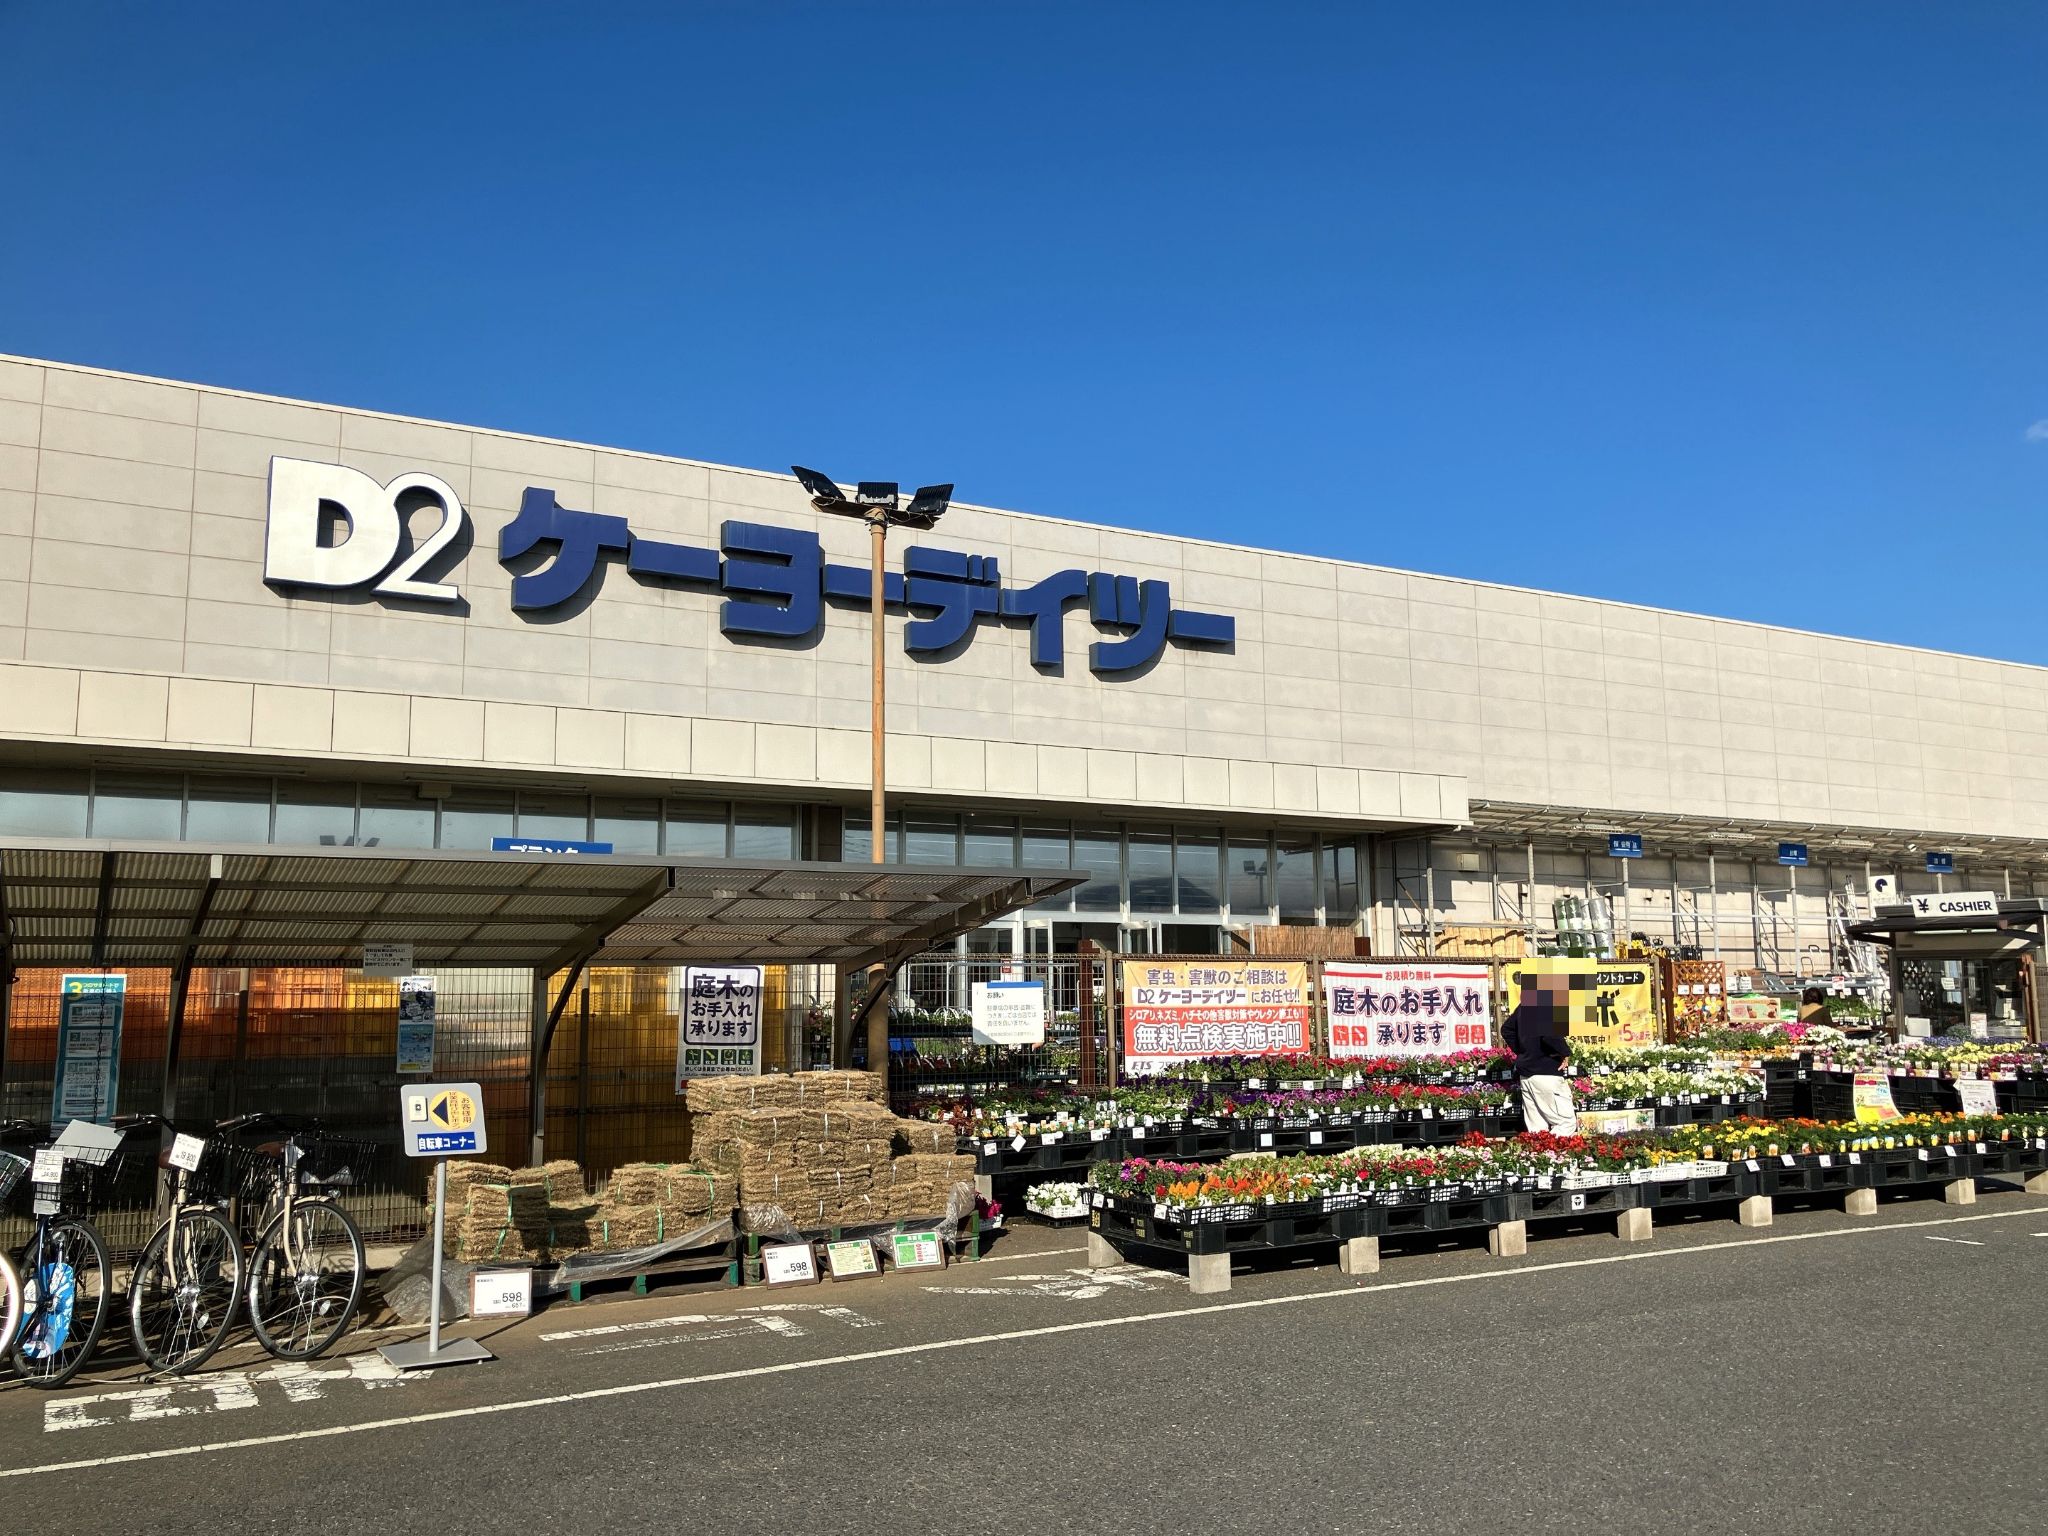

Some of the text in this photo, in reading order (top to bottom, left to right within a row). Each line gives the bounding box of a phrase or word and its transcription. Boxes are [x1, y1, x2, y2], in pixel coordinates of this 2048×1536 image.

[264, 456, 462, 601] D2
[1939, 900, 1993, 913] CASHIER
[1147, 968, 1288, 986] 害虫・害獣のご相談は
[1384, 971, 1432, 981] お見積り無料
[1597, 972, 1640, 984] イントカード
[691, 974, 754, 999] 庭木の
[1137, 988, 1155, 1004] D2
[1332, 986, 1484, 1016] 庭木のお手入れ
[690, 1001, 753, 1017] お手入れ
[690, 1020, 752, 1037] 承ります
[1377, 1021, 1446, 1046] 承ります
[418, 1136, 475, 1150] 自転車コーナー
[790, 1261, 808, 1272] 598
[502, 1291, 523, 1303] 598
